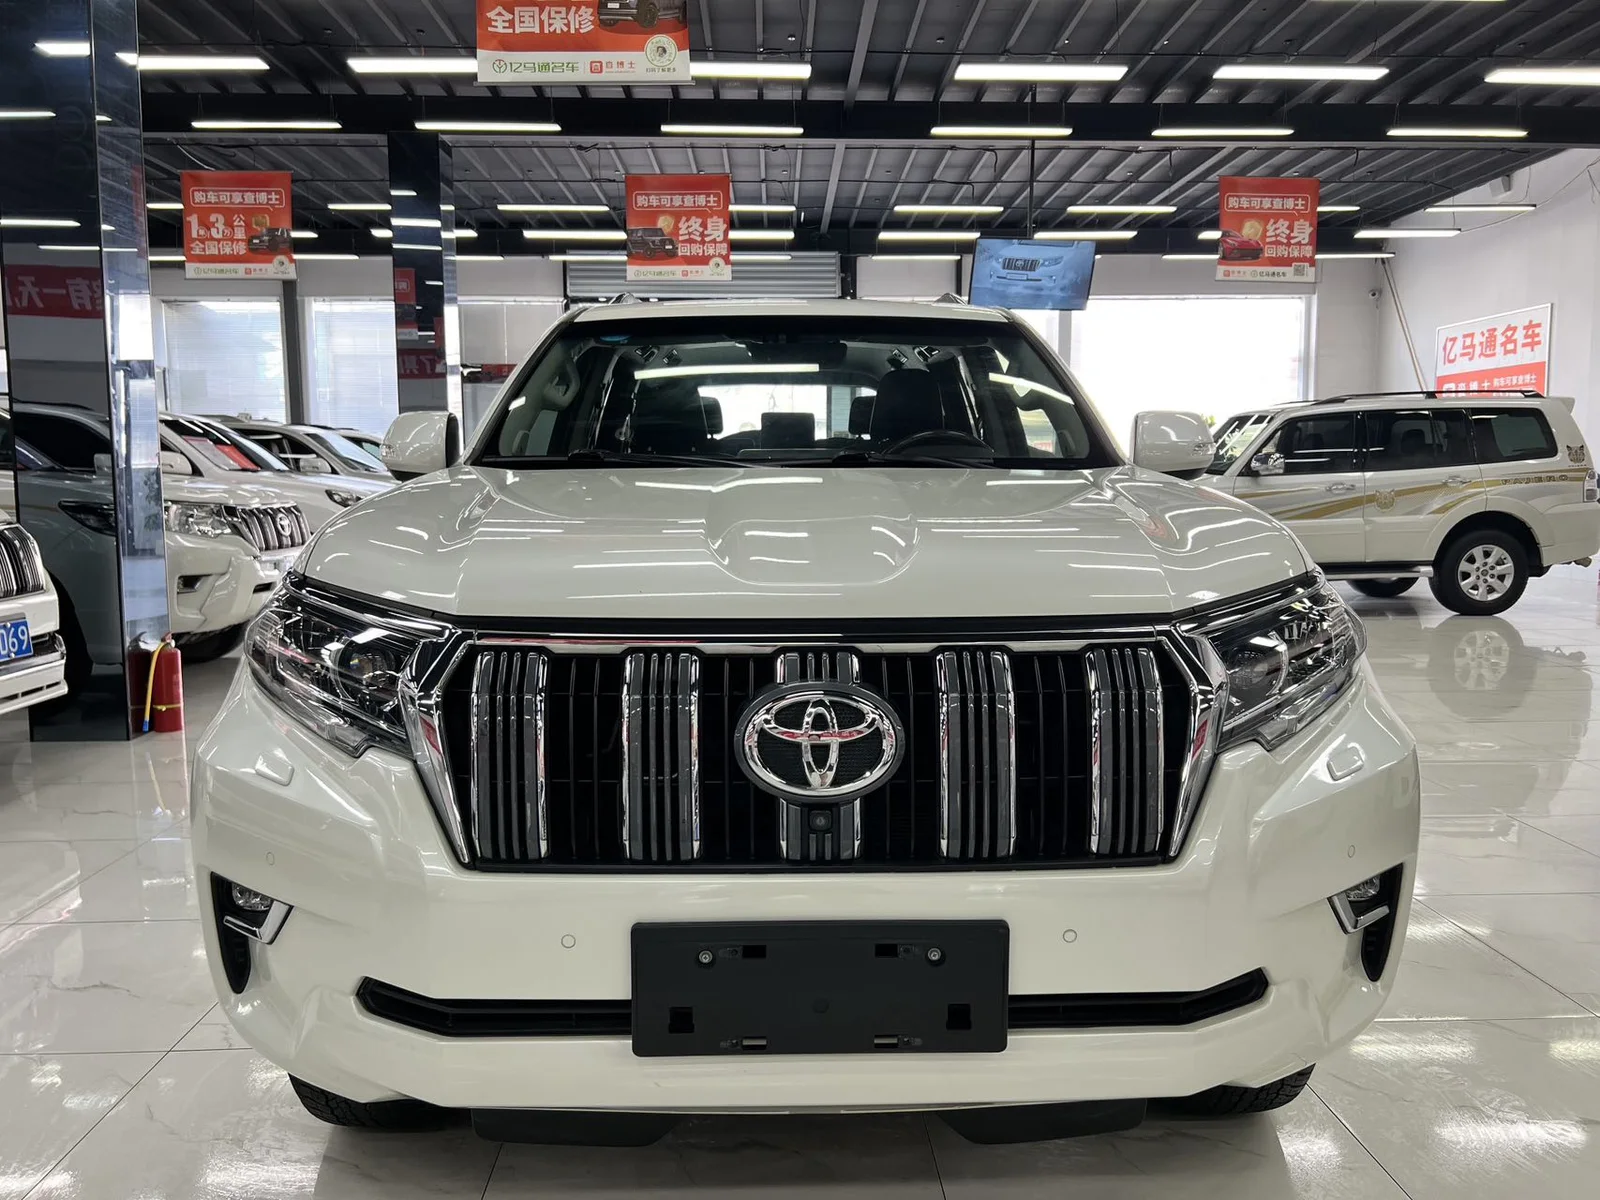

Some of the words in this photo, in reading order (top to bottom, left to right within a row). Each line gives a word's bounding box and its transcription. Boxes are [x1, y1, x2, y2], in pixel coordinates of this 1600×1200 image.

[486, 6, 594, 34] 全国保修
[508, 61, 580, 73] 亿马通名车
[194, 191, 280, 204] 购车可享查博士
[636, 194, 718, 207] 购车可享查博士
[1228, 197, 1305, 210] 购车可享查博士
[678, 215, 728, 242] 终身
[1265, 219, 1313, 244] 终身
[190, 240, 247, 256] 全国保修
[678, 243, 728, 256] 回购保障
[1264, 245, 1313, 258] 回购保障
[1443, 319, 1542, 366] 亿马通名车
[1501, 474, 1569, 485] PAJERO
